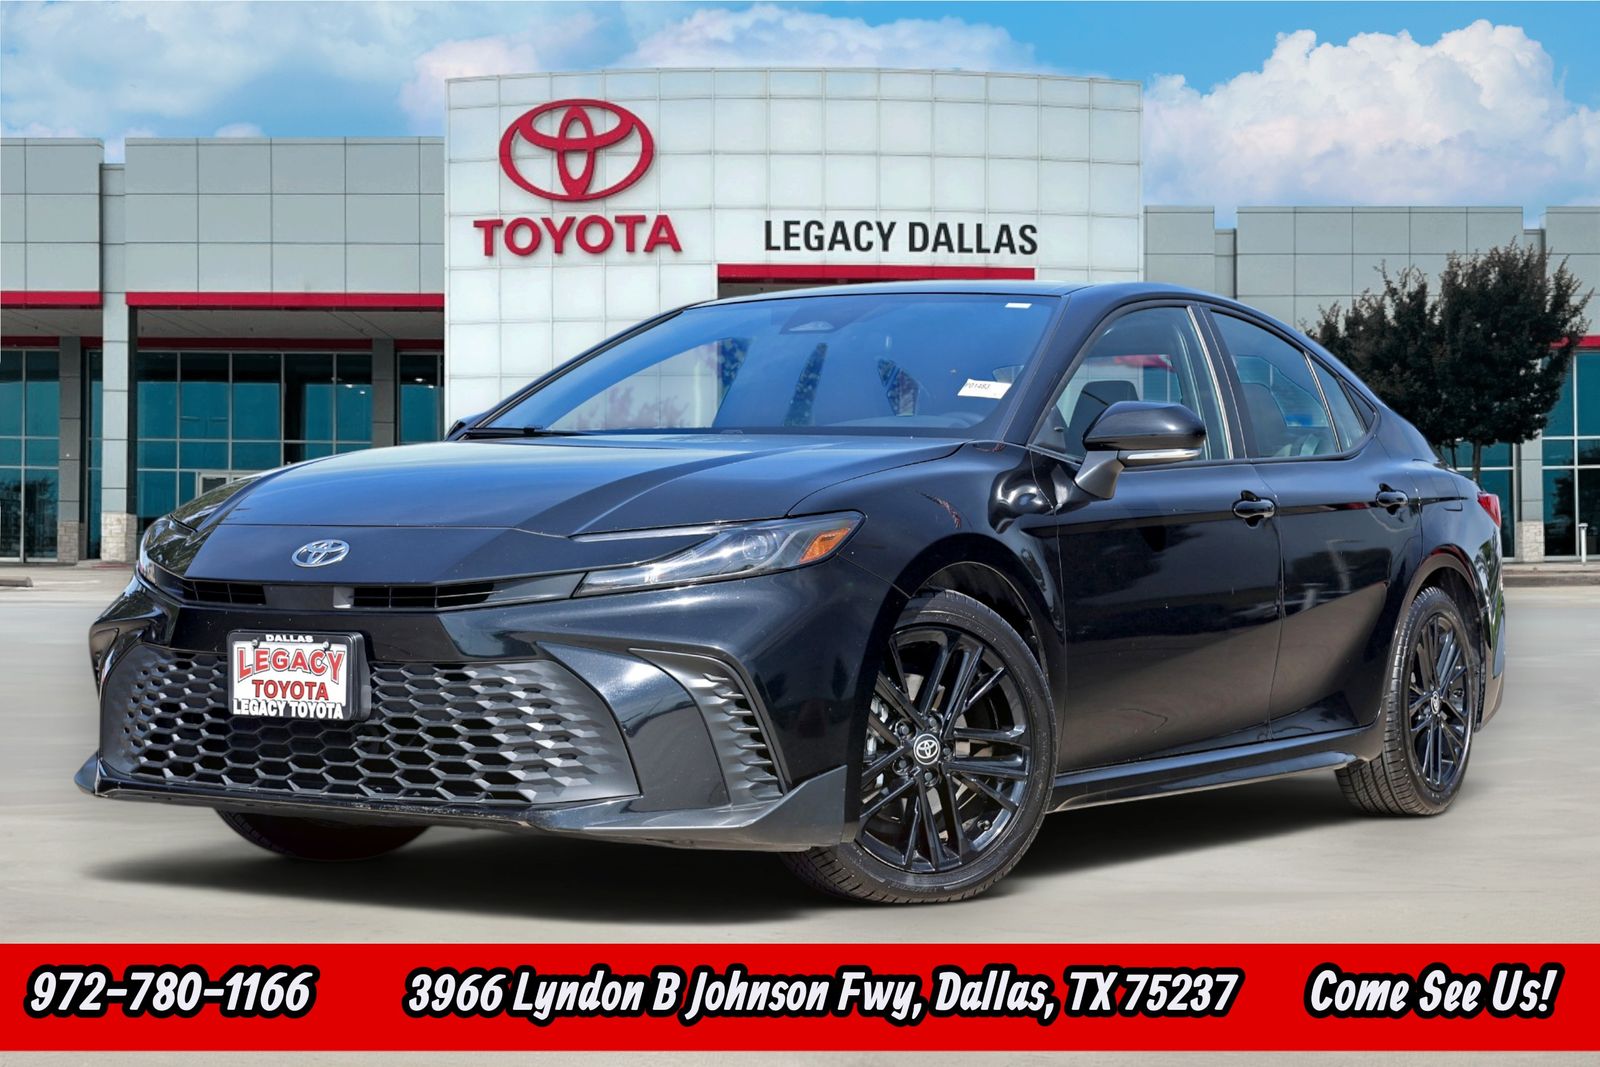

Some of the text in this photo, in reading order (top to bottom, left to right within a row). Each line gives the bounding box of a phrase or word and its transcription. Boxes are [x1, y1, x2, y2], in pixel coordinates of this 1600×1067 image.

[474, 214, 682, 256] TOYOTA
[765, 220, 1038, 255] LEGACY DALLAS
[265, 634, 314, 643] DALLAS
[236, 647, 346, 684] LEGACY
[251, 679, 330, 701] TOYOTA
[233, 698, 344, 719] LEGACY TOYOTA
